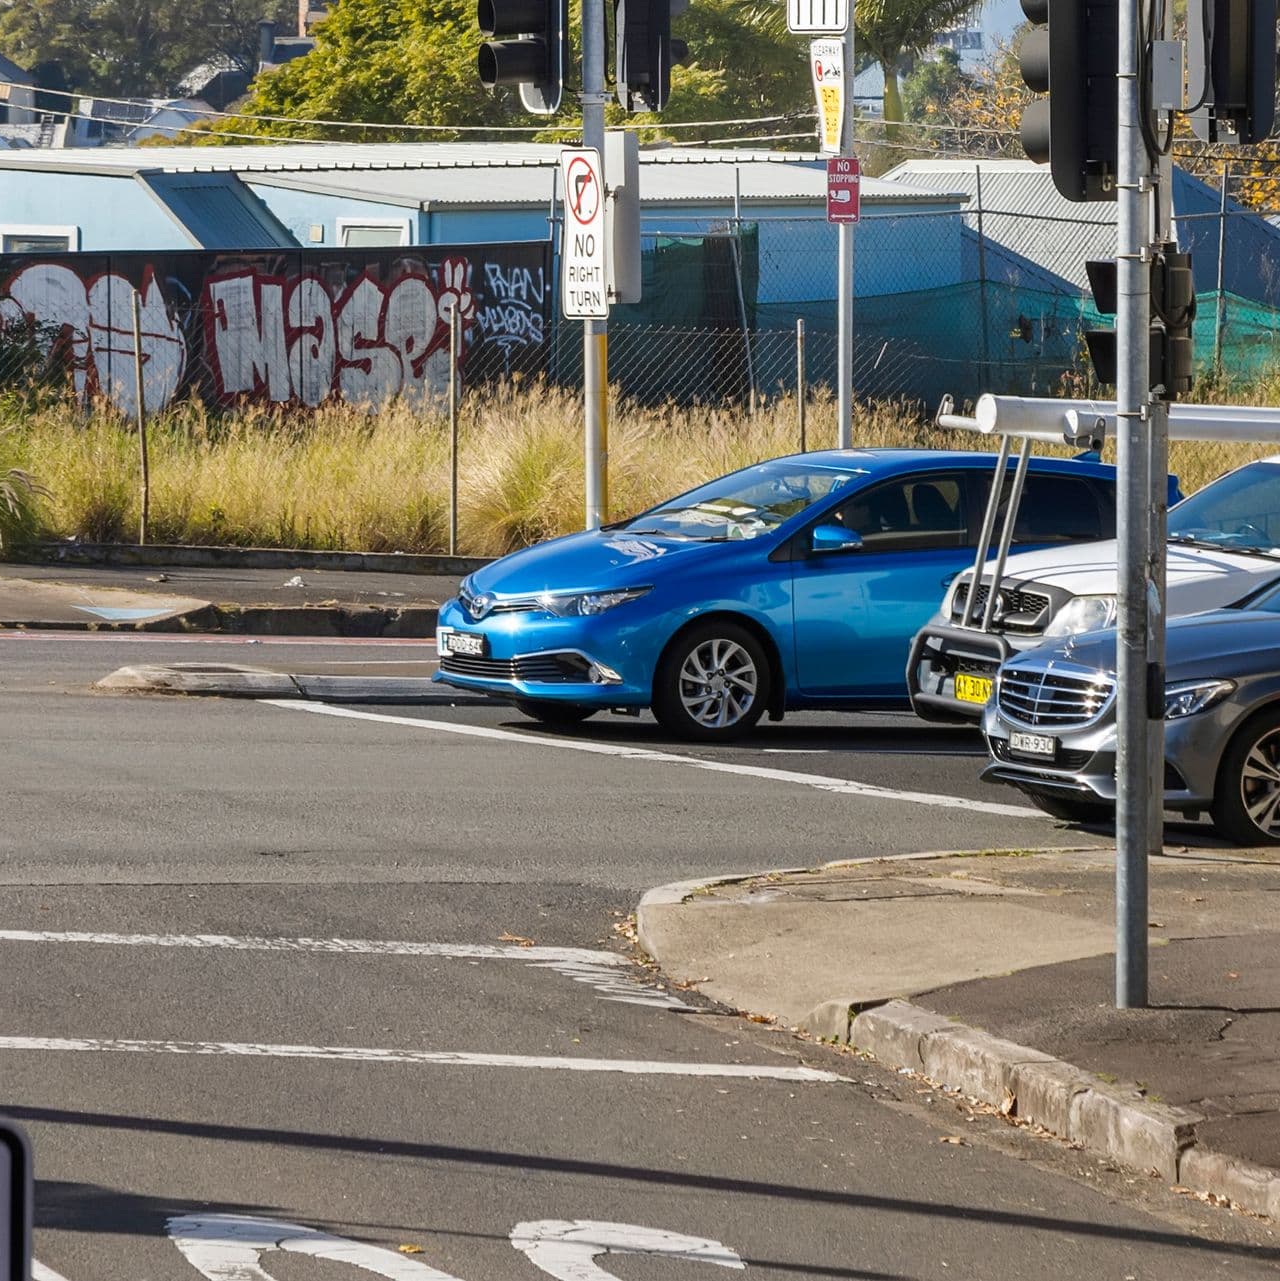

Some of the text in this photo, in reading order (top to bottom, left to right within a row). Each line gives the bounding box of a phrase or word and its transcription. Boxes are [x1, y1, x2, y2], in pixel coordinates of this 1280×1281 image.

[837, 161, 851, 172] NO
[829, 173, 860, 184] STOPPING
[574, 233, 595, 258] NO
[568, 266, 601, 283] RIGHT
[568, 290, 602, 308] TURN
